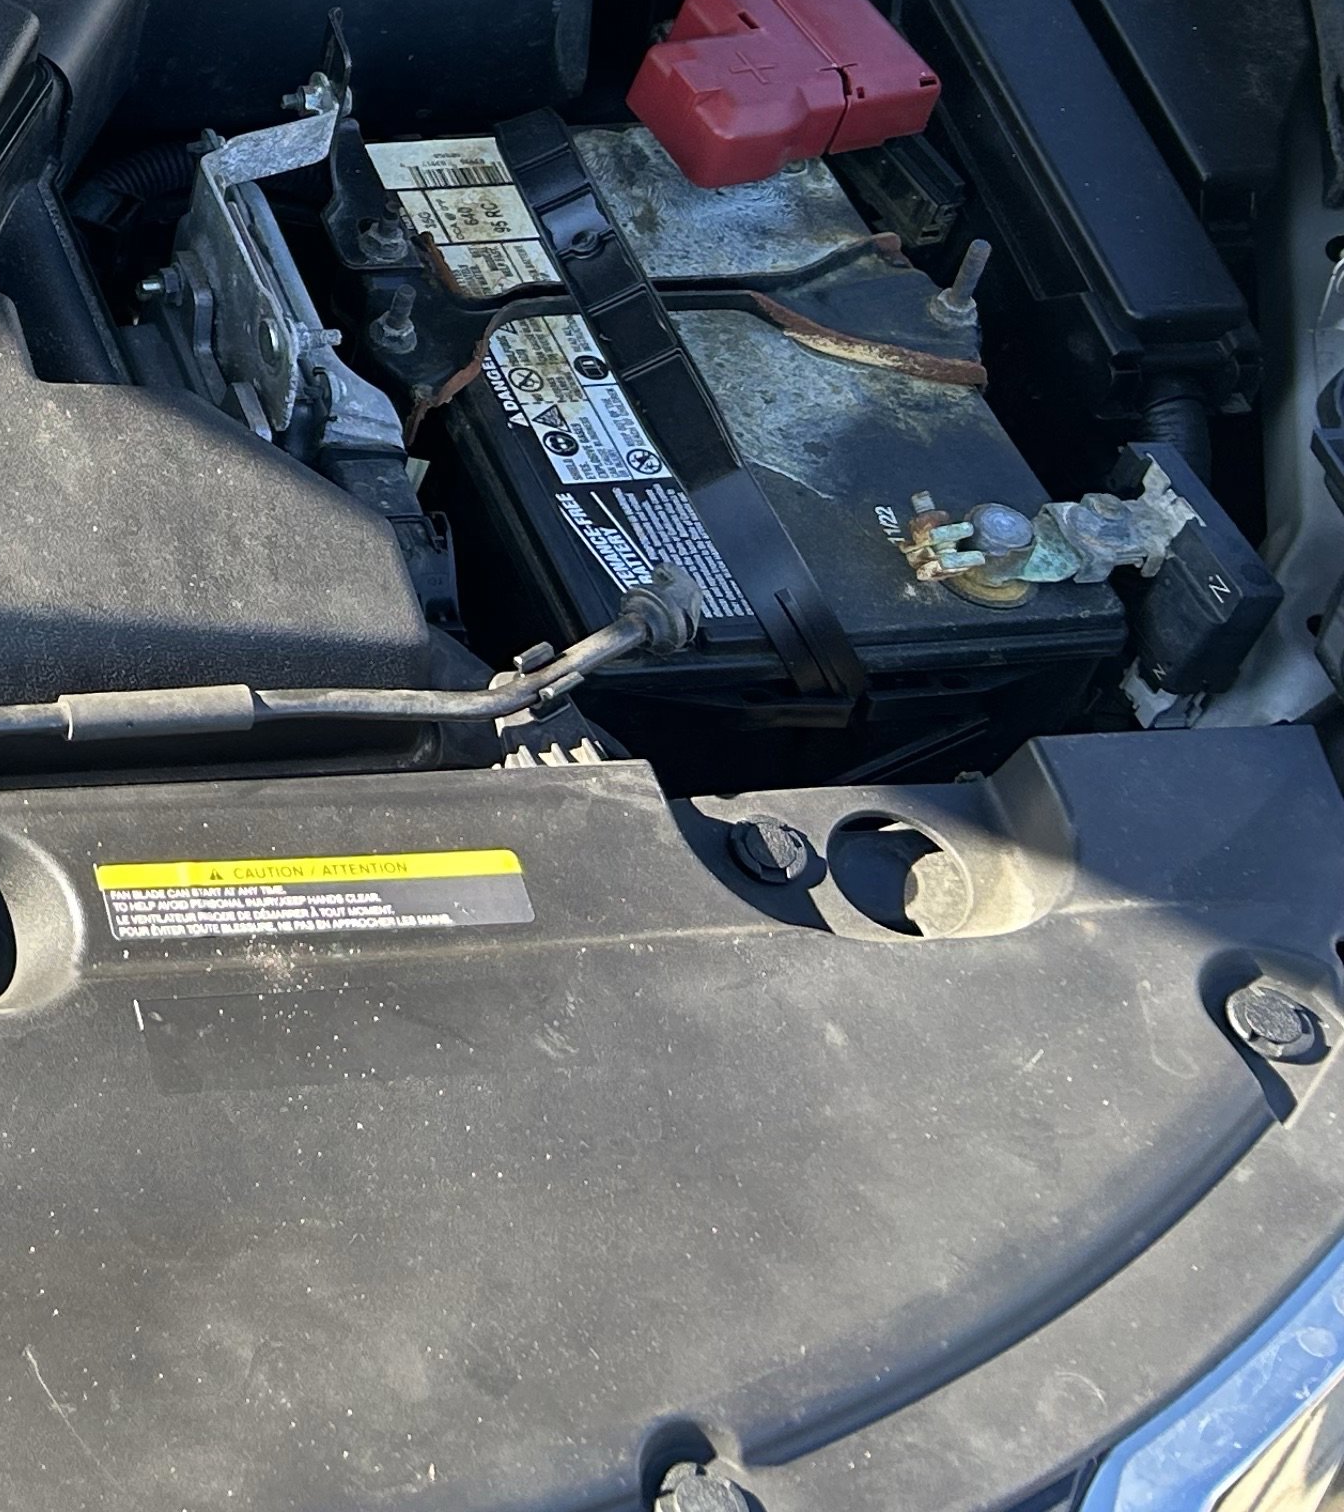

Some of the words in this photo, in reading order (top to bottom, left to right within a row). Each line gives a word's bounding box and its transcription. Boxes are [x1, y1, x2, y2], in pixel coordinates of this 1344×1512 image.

[455, 206, 481, 225] 640
[478, 202, 503, 217] RC
[490, 220, 512, 232] 95
[875, 506, 906, 544] 11/22
[555, 492, 641, 589] TENANCE-FREE
[233, 866, 304, 880] CAUTION
[322, 862, 408, 877] ATTENTION
[110, 890, 132, 901] FAN
[132, 889, 165, 900] BLADE
[166, 888, 190, 899] CAN
[191, 887, 222, 898] START
[112, 902, 129, 913] TO
[129, 901, 156, 912] HELP
[157, 900, 189, 911] AVOID
[306, 894, 345, 905] HANDS
[115, 914, 131, 926] LE
[131, 912, 197, 925] VENTILATEUR
[237, 910, 253, 921] DE
[319, 906, 347, 918] TOUT
[118, 926, 150, 938] POUR
[186, 923, 221, 935] TOUTE
[332, 916, 396, 929] APPROCHER
